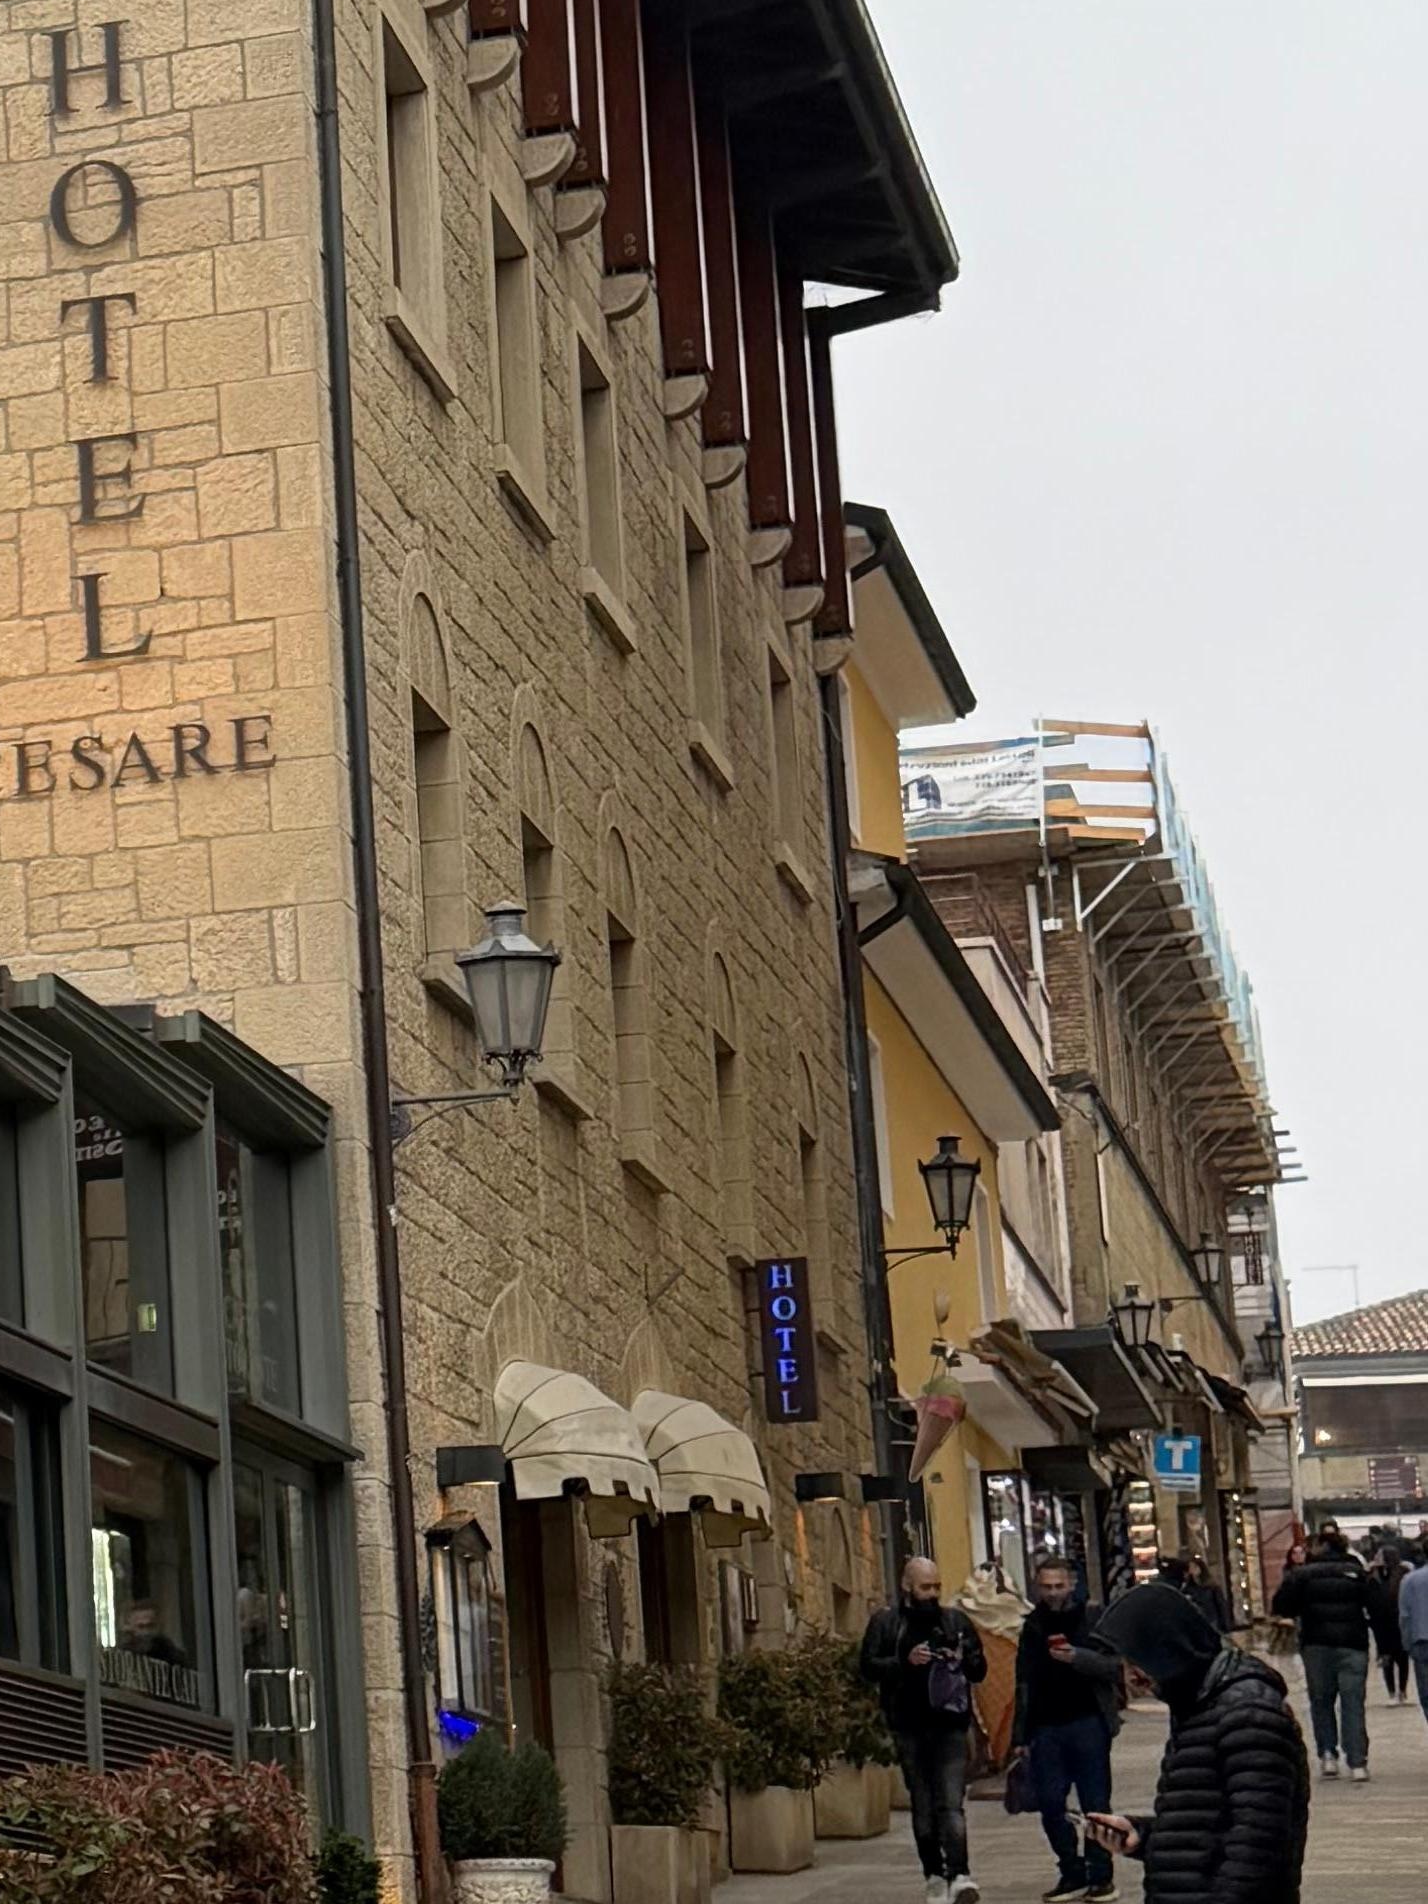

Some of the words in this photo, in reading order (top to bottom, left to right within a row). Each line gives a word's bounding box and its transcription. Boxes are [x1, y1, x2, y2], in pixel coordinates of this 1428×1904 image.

[43, 19, 152, 663] HOTEL
[769, 1264, 802, 1415] HOTEL
[1164, 1440, 1193, 1470] T
